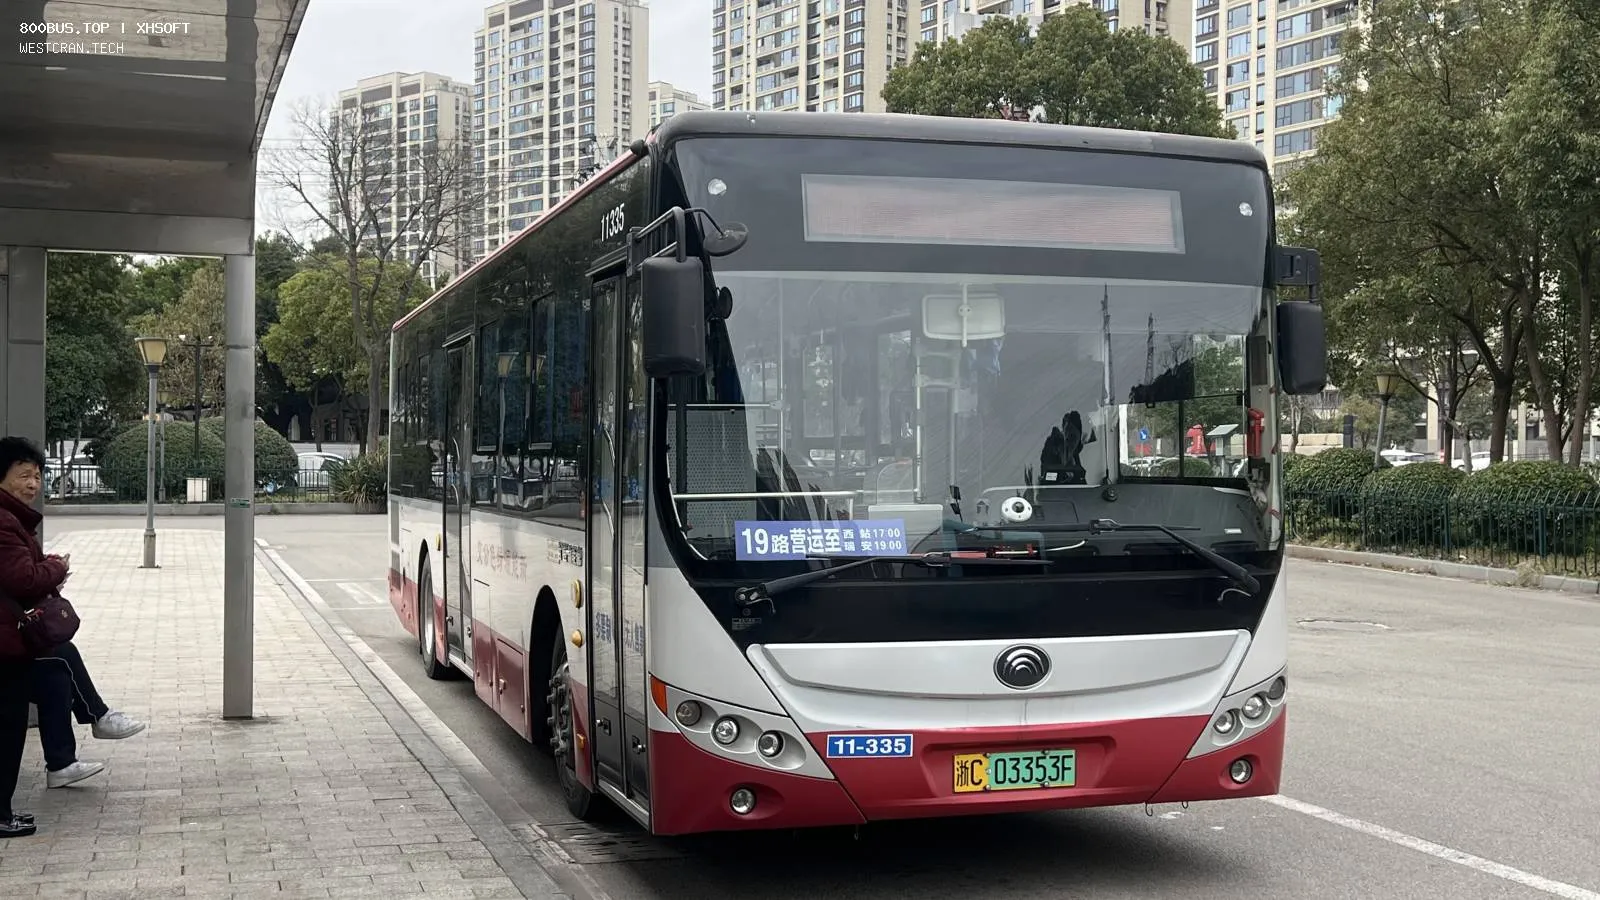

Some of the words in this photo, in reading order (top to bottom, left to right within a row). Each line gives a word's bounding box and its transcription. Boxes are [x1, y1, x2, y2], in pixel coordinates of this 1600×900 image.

[600, 202, 625, 242] 11335
[833, 737, 907, 755] 11-335
[993, 754, 1074, 785] 03353F
